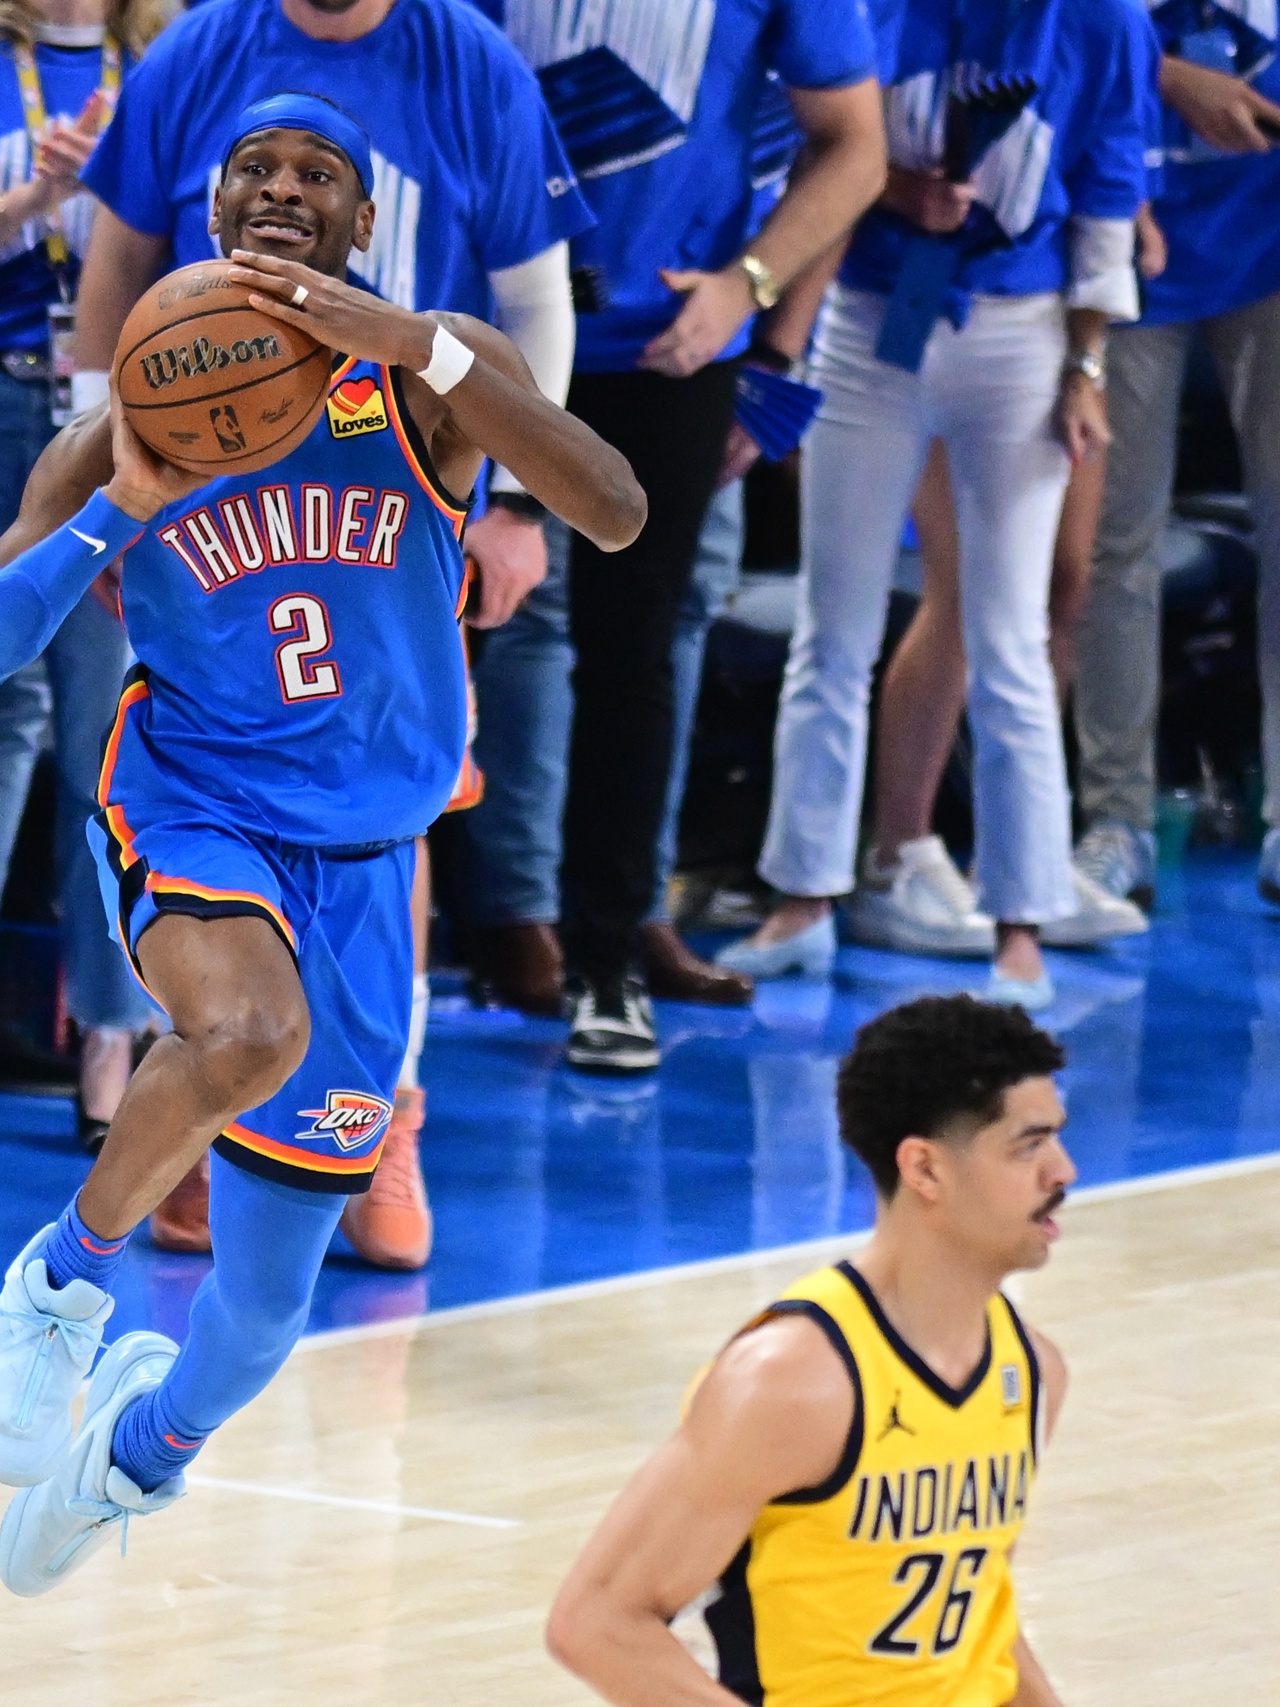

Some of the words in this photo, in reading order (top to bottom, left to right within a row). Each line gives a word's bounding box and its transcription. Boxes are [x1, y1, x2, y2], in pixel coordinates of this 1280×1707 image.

[139, 334, 282, 391] Wilson
[157, 483, 410, 594] THUNDER
[267, 591, 343, 705] 2
[317, 1107, 380, 1130] OKC
[848, 1451, 1028, 1542] INDIANA
[869, 1547, 989, 1656] 26
